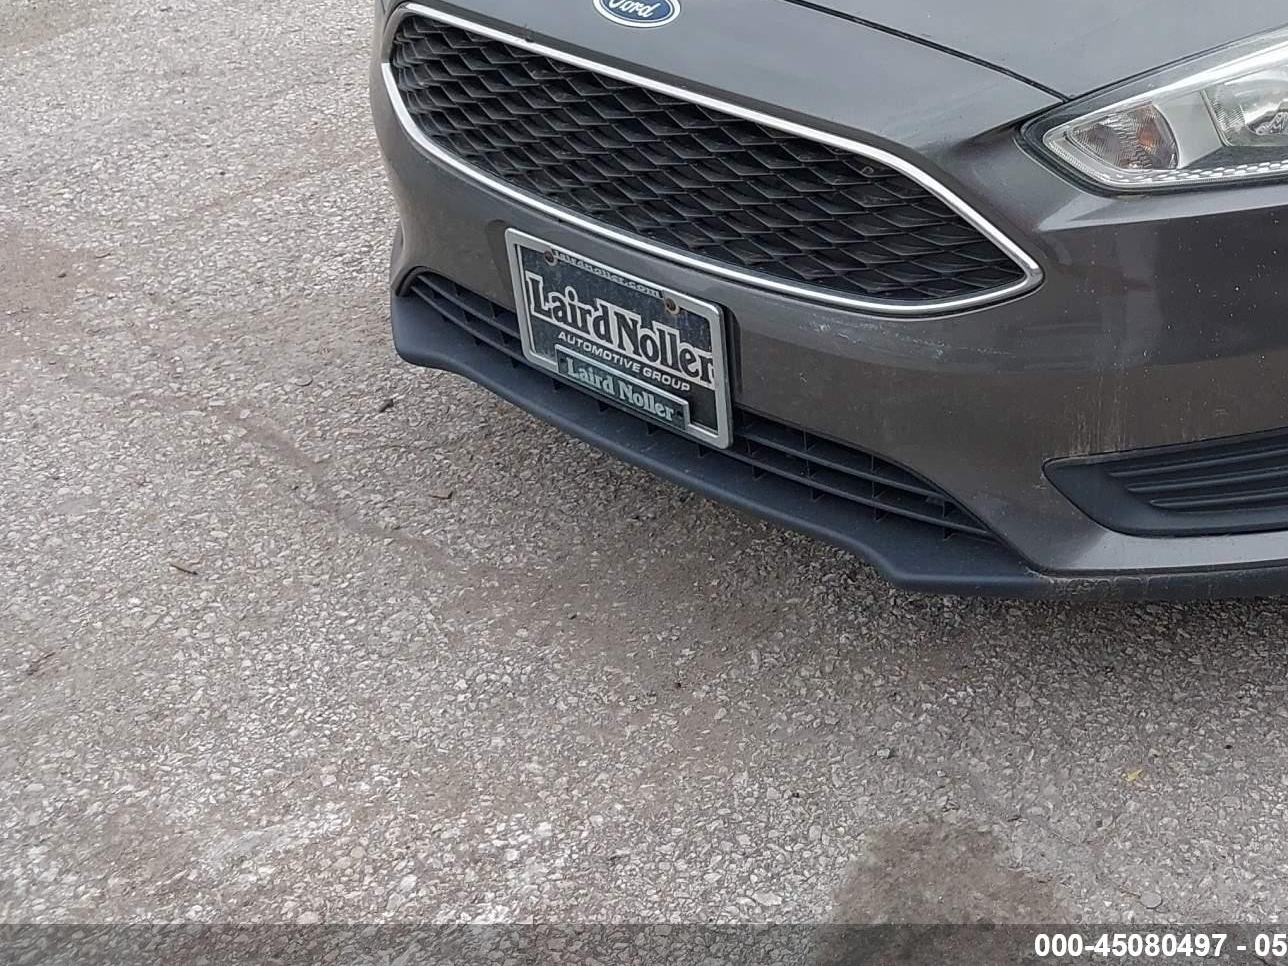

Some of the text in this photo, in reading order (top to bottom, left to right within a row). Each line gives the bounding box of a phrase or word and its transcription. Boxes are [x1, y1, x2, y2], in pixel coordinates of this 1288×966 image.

[558, 331, 691, 392] AUTOMOTIVE GROUP
[566, 357, 675, 421] Laird Noller
